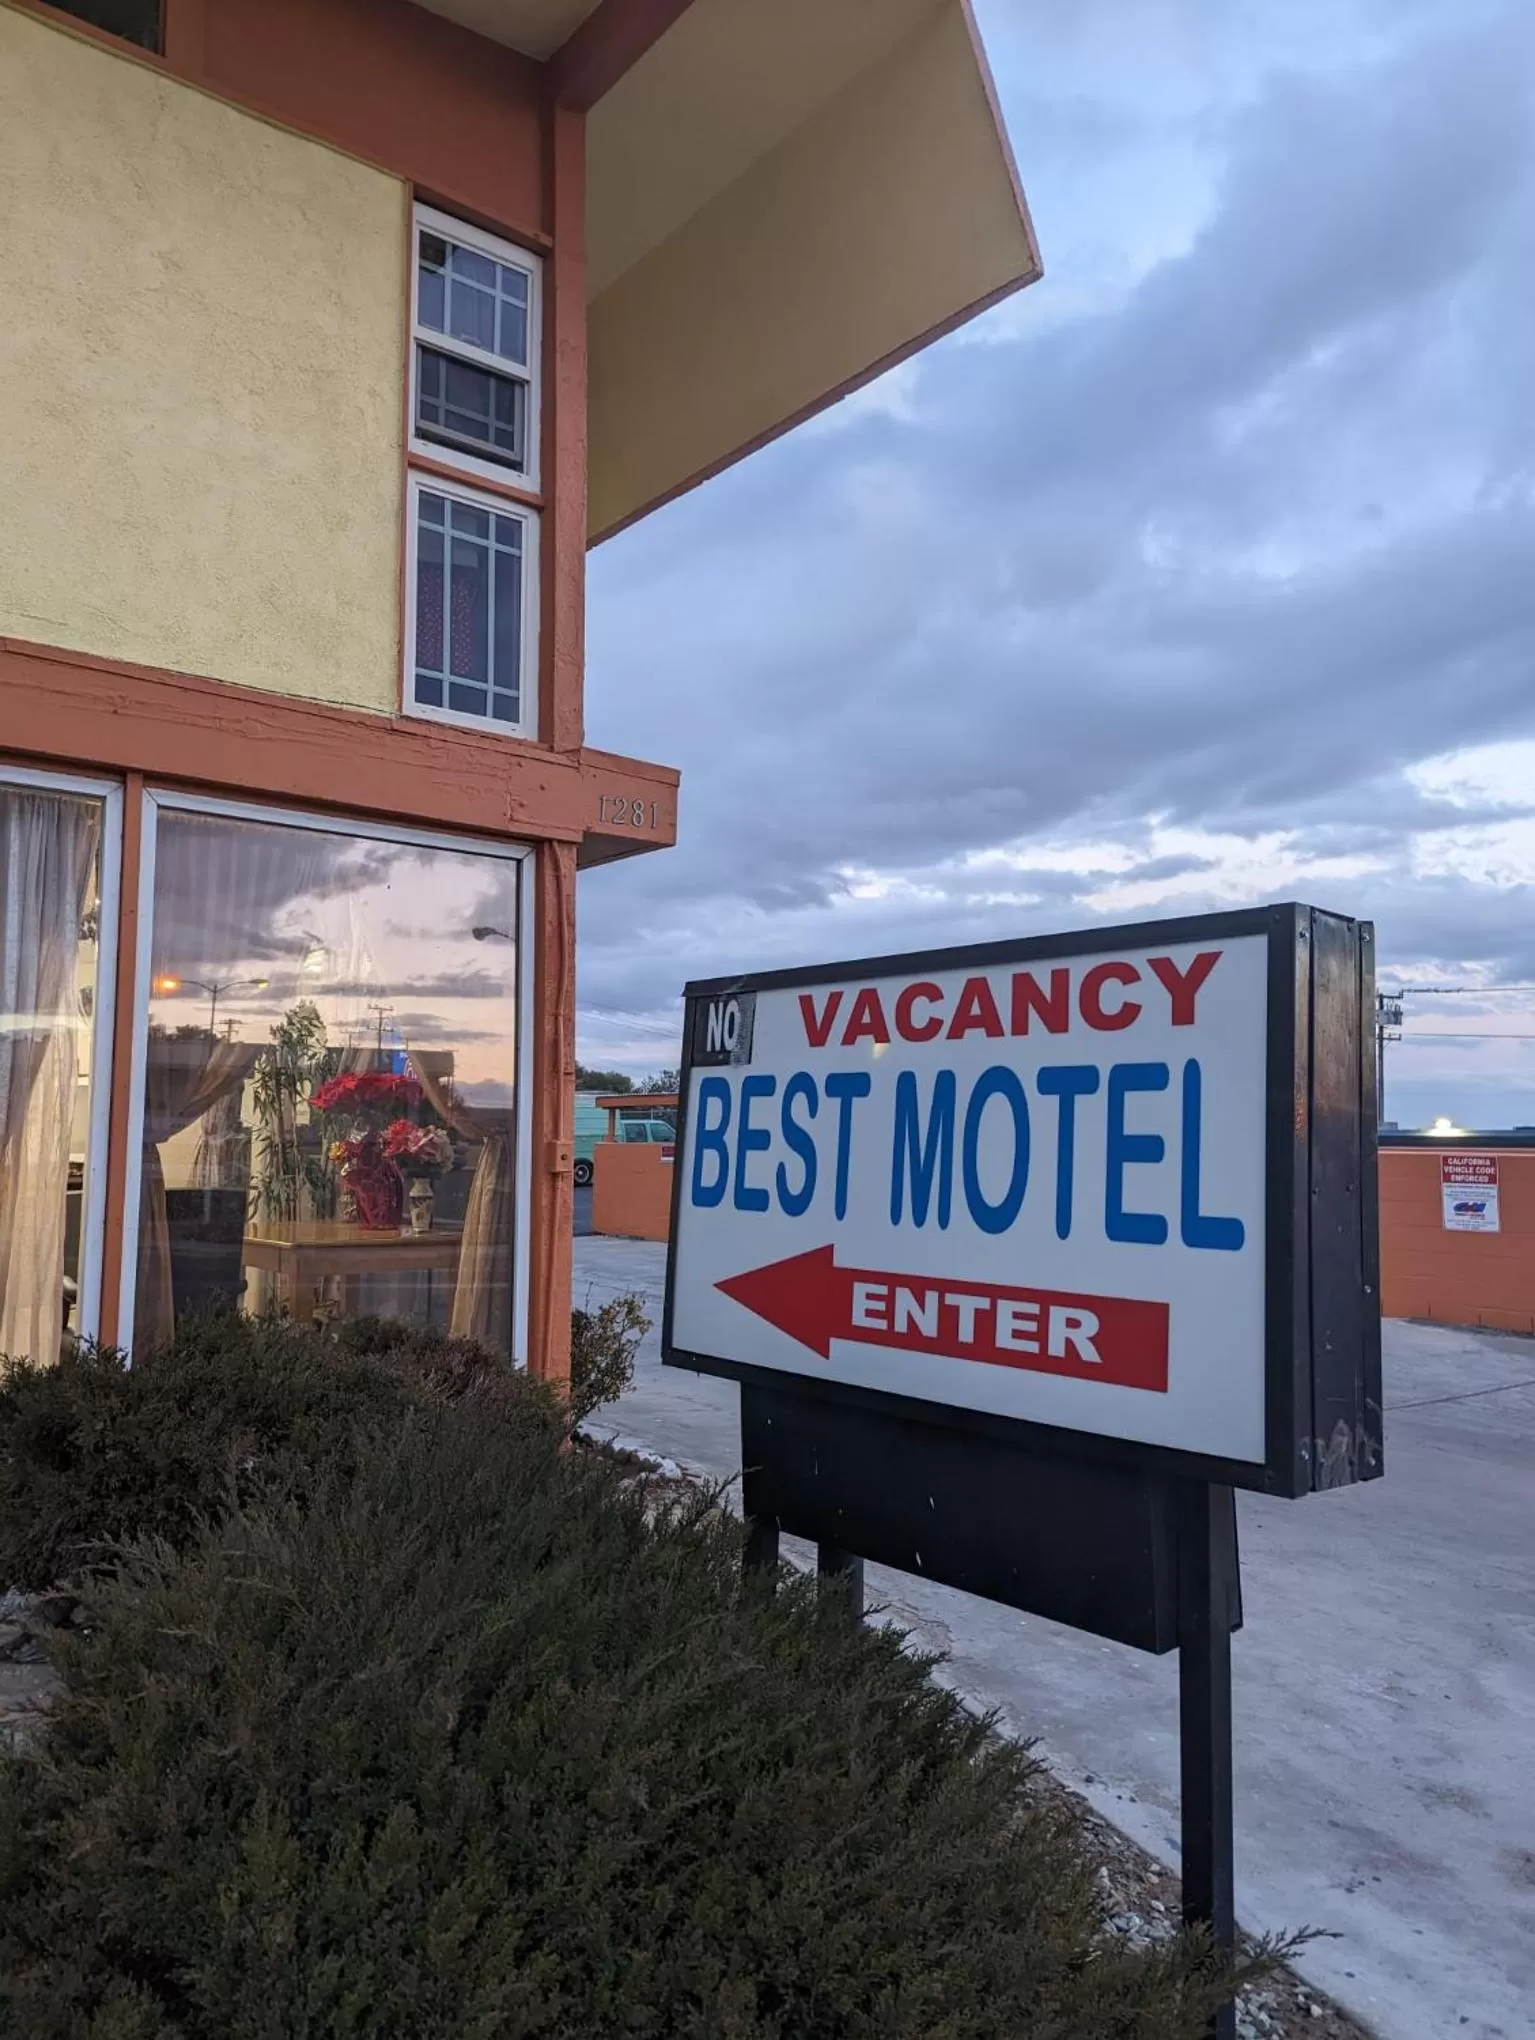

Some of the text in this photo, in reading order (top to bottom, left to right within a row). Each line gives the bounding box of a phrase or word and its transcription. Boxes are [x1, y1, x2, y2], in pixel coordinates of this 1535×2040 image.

[600, 796, 657, 829] 1281
[706, 951, 1223, 1052] NO VACANCY
[691, 1057, 1245, 1251] BEST MOTEL
[1444, 1165, 1495, 1174] VEHICLE CODE
[1447, 1158, 1490, 1166] CALIFORNIA
[851, 1281, 1103, 1363] ENTER
